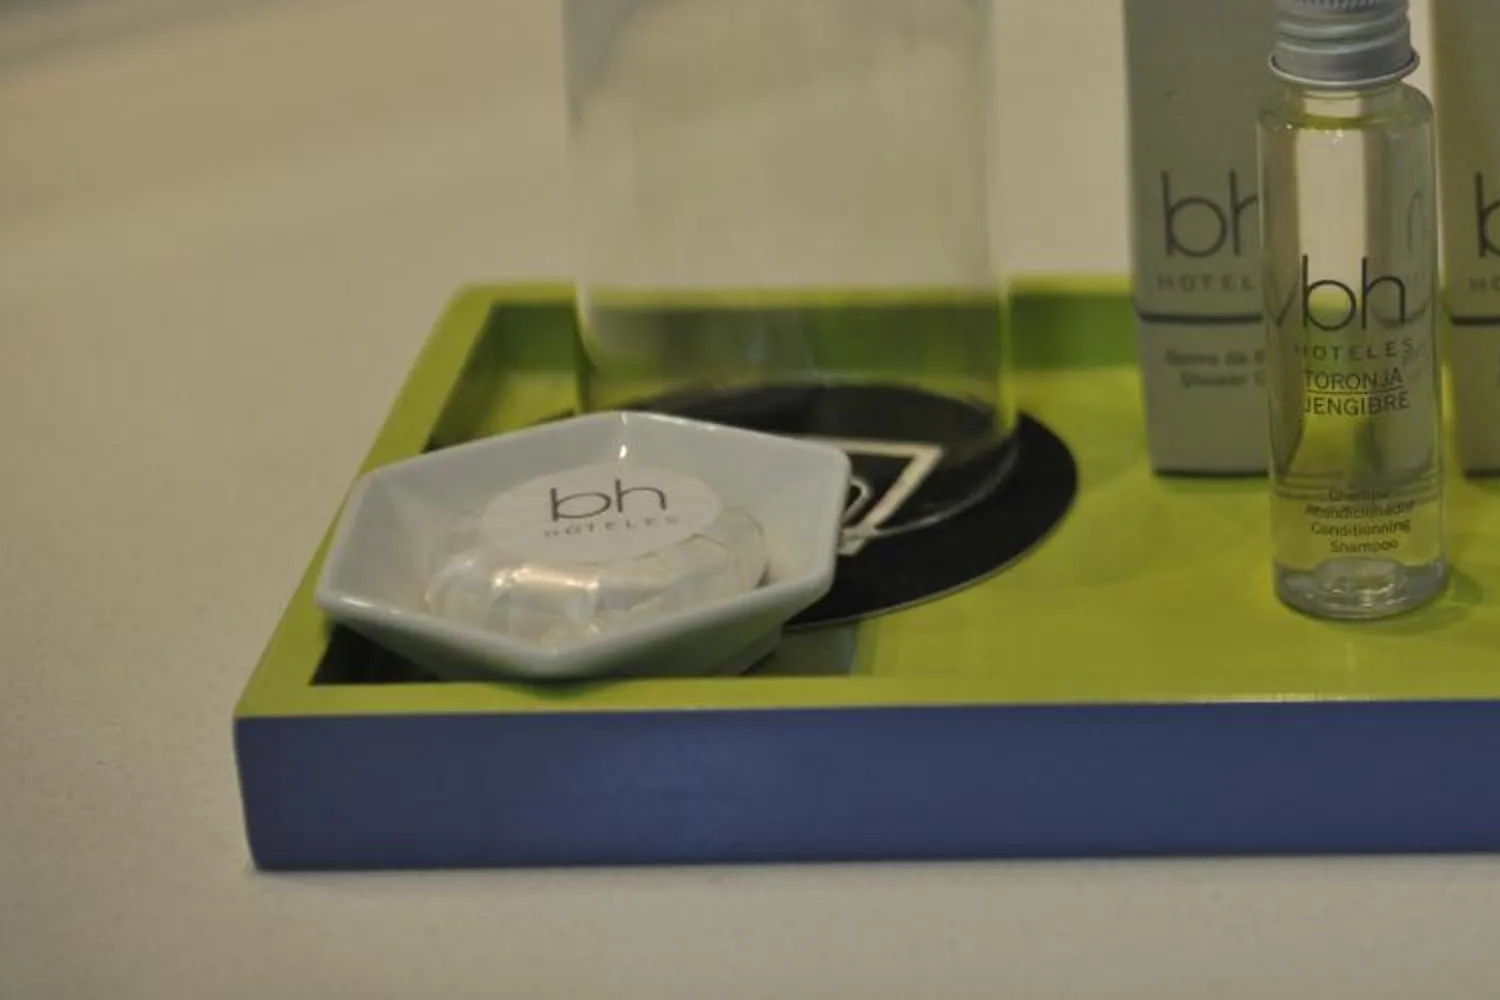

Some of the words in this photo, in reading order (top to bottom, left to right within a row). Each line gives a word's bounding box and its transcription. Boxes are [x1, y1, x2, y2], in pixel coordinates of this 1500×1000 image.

[1157, 273, 1257, 293] HOTEL
[1302, 254, 1406, 331] bh
[1293, 337, 1414, 361] HOTELES
[1302, 365, 1405, 391] TORONJA
[1304, 391, 1411, 416] JENGIBRE
[550, 478, 668, 521] bh
